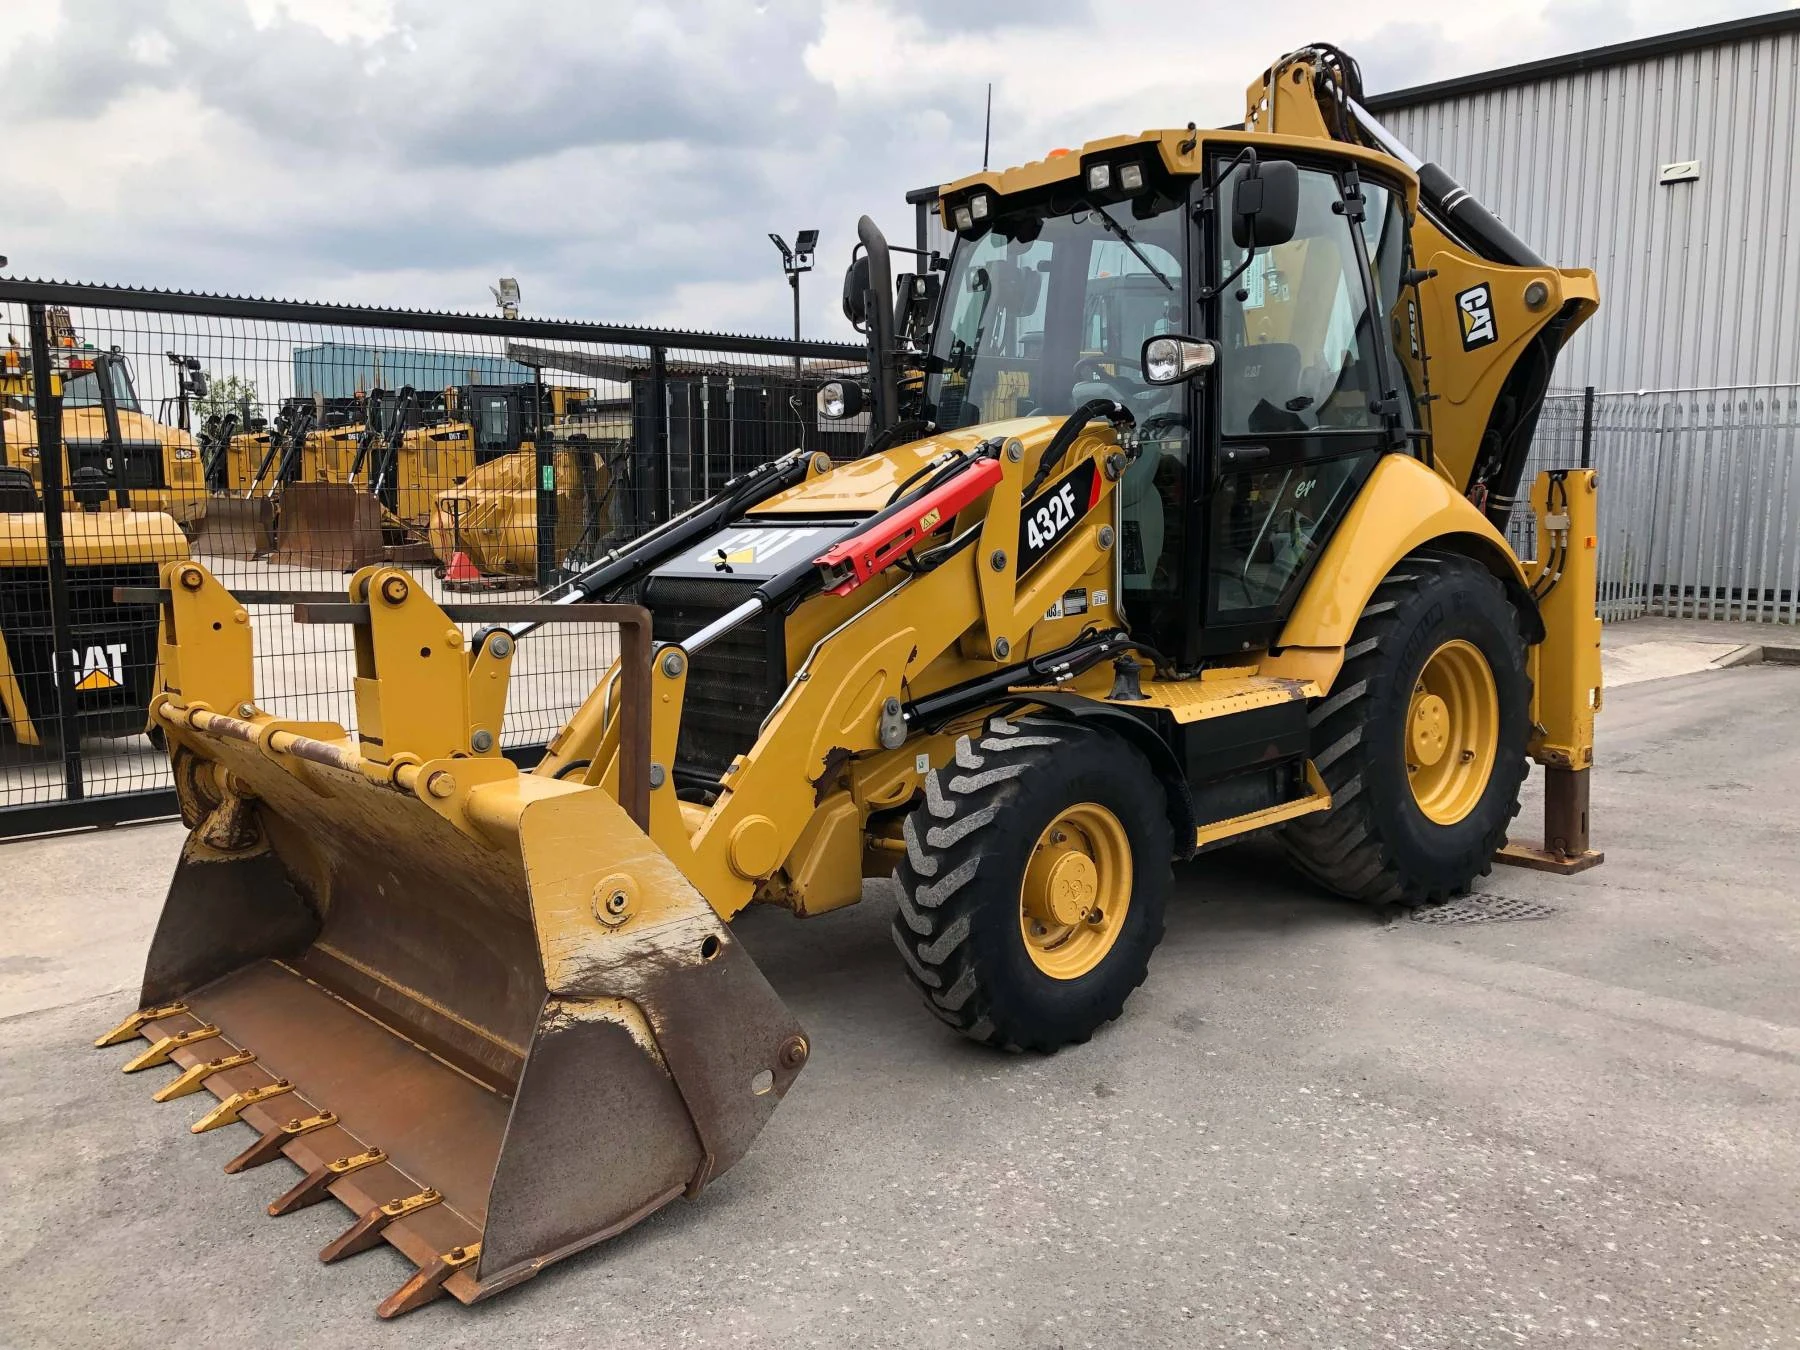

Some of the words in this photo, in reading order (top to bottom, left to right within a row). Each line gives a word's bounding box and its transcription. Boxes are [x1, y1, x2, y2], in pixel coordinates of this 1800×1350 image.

[1460, 287, 1495, 343] CAT
[106, 457, 129, 471] CT
[1027, 482, 1076, 550] 432F
[698, 529, 820, 564] CAT
